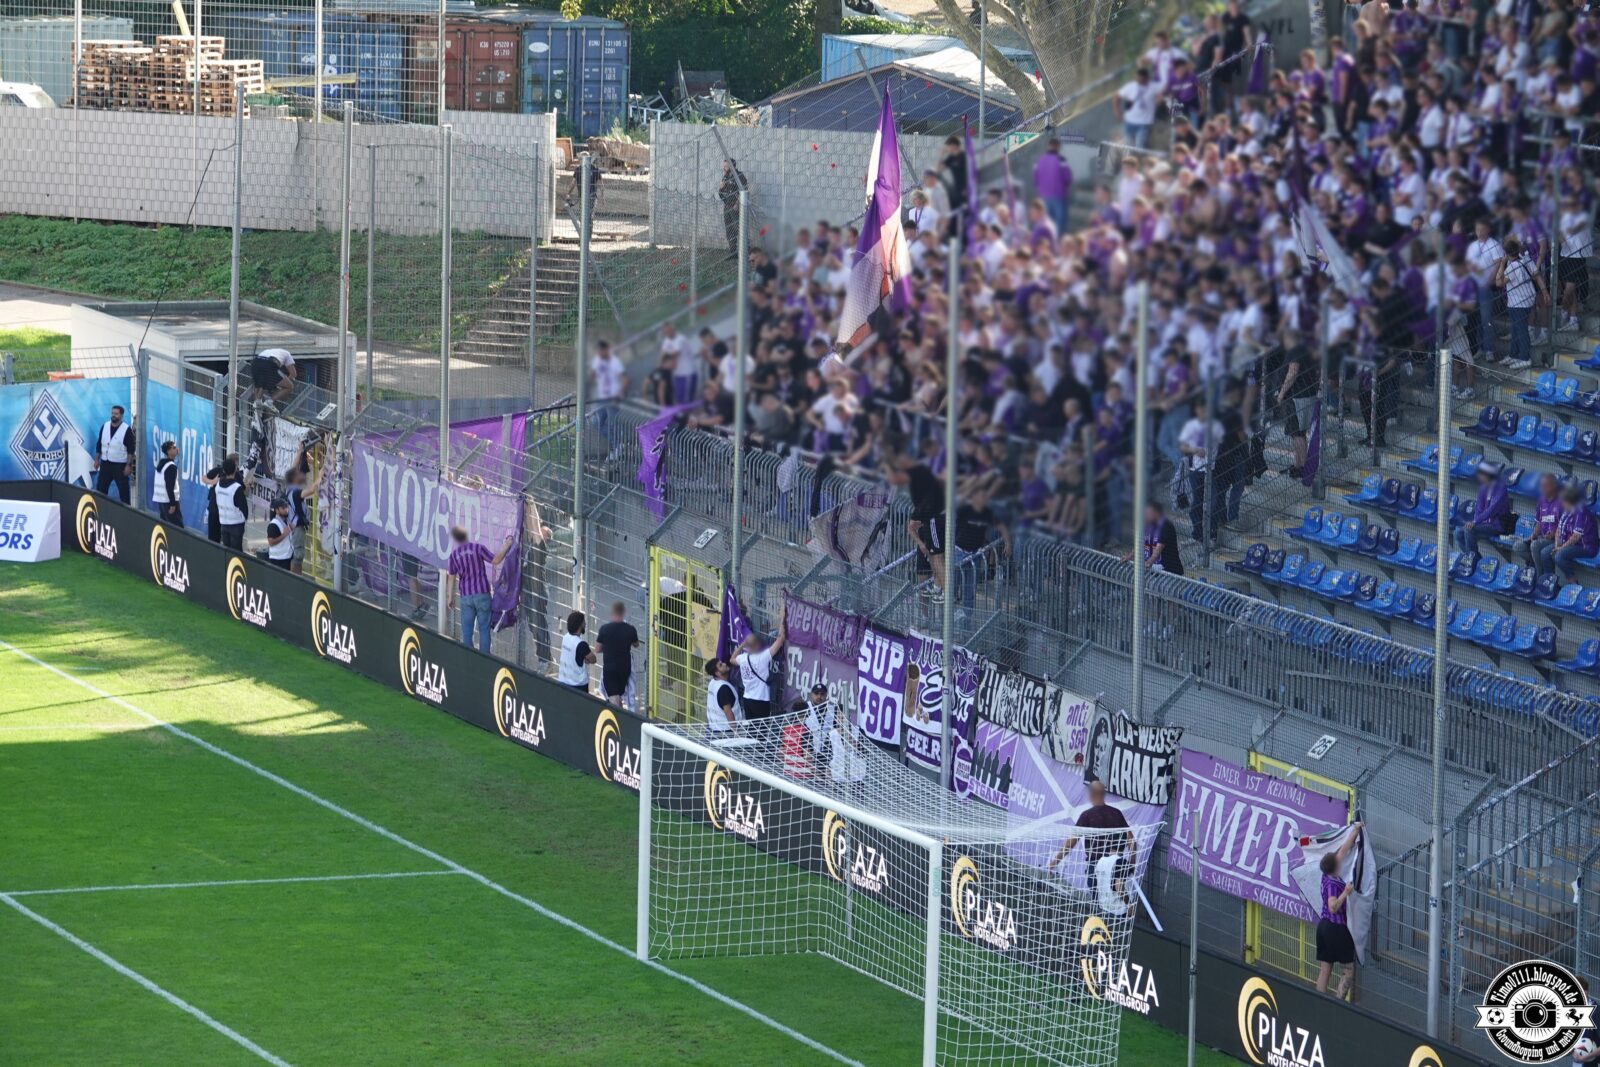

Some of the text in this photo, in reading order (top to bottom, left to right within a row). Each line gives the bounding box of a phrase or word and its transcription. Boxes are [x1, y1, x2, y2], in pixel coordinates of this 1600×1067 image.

[40, 461, 58, 477] 07
[88, 517, 117, 553] PLAZA
[160, 549, 190, 587] PLAZA
[236, 582, 272, 621] PLAZA
[322, 616, 357, 657] PLAZA
[411, 654, 448, 697] PLAZA
[858, 635, 905, 685] SUP
[505, 695, 546, 740] PLAZA
[1066, 701, 1090, 728] anti
[510, 726, 540, 747] HOTELGROUP
[1311, 738, 1334, 757] 25
[607, 738, 641, 780] PLAZ
[1213, 762, 1307, 808] EIMER IST KEINMAL
[718, 784, 765, 834] PLAZA
[725, 817, 758, 840] HOTELGROUP
[1173, 777, 1300, 887] EIMER
[838, 834, 889, 886] PAZA
[966, 889, 1018, 945] PLAZA
[973, 925, 1010, 950] HOTELGROUP
[1097, 949, 1160, 1007] PLAZA
[1105, 988, 1150, 1015] HOTELGROUP
[1258, 1012, 1325, 1067] PLAZA
